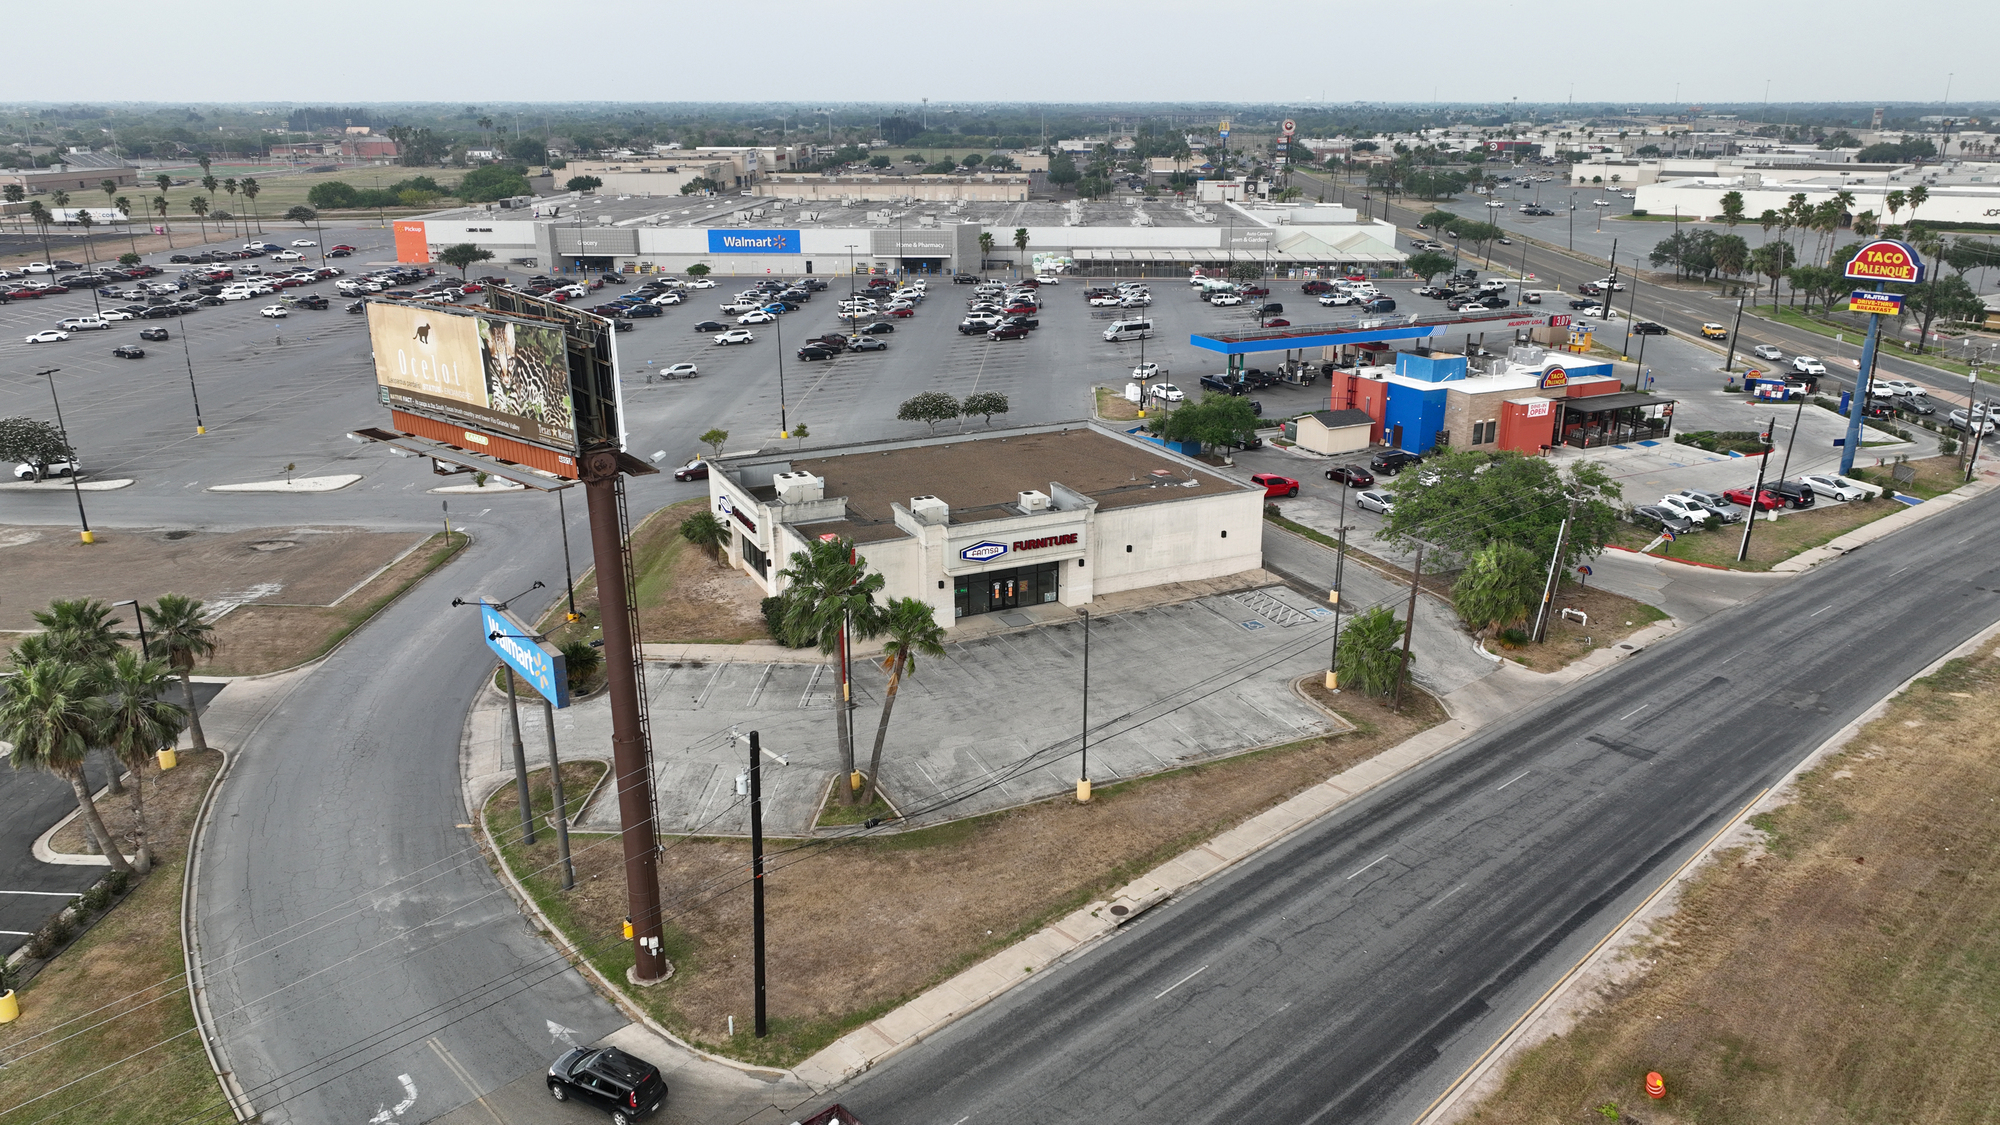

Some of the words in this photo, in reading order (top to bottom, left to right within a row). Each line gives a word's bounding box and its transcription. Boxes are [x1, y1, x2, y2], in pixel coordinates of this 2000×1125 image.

[723, 236, 772, 247] Walmart
[1867, 251, 1904, 264] TACO
[1853, 262, 1911, 278] PALENQUE
[1857, 299, 1893, 308] DRIVE-THRU
[398, 348, 460, 386] Ocelot
[1013, 533, 1078, 552] FURNITURE
[972, 546, 998, 557] FAMSA
[488, 615, 534, 676] Walmart
